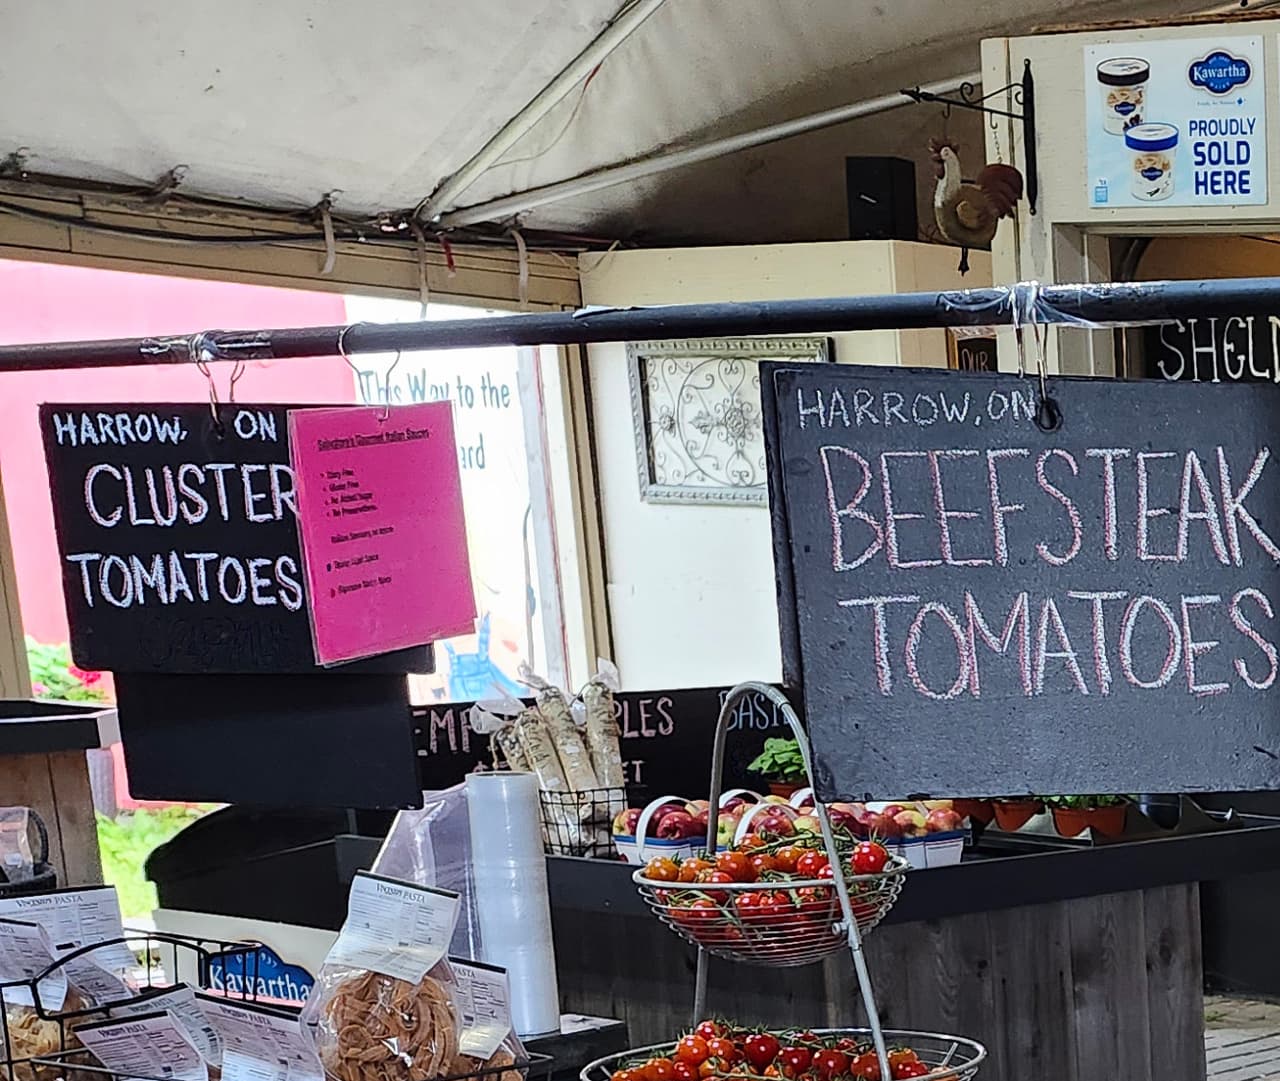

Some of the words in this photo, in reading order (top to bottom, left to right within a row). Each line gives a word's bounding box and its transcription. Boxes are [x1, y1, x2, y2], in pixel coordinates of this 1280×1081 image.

[1193, 64, 1246, 82] Kawartha
[1189, 118, 1256, 137] PROUDLY
[1193, 141, 1250, 166] SOLD
[1195, 170, 1250, 195] HERE
[359, 370, 402, 403] This
[457, 375, 474, 409] to
[481, 371, 511, 409] the
[53, 412, 188, 448] HARROW,
[234, 410, 277, 442] ON
[84, 463, 298, 528] CLUSTER
[66, 552, 302, 611] TOMATOES
[838, 588, 1279, 700] TOMATOES
[54, 894, 84, 904] PASTA
[403, 890, 425, 903] PASTA
[210, 964, 310, 1003] Kawartha
